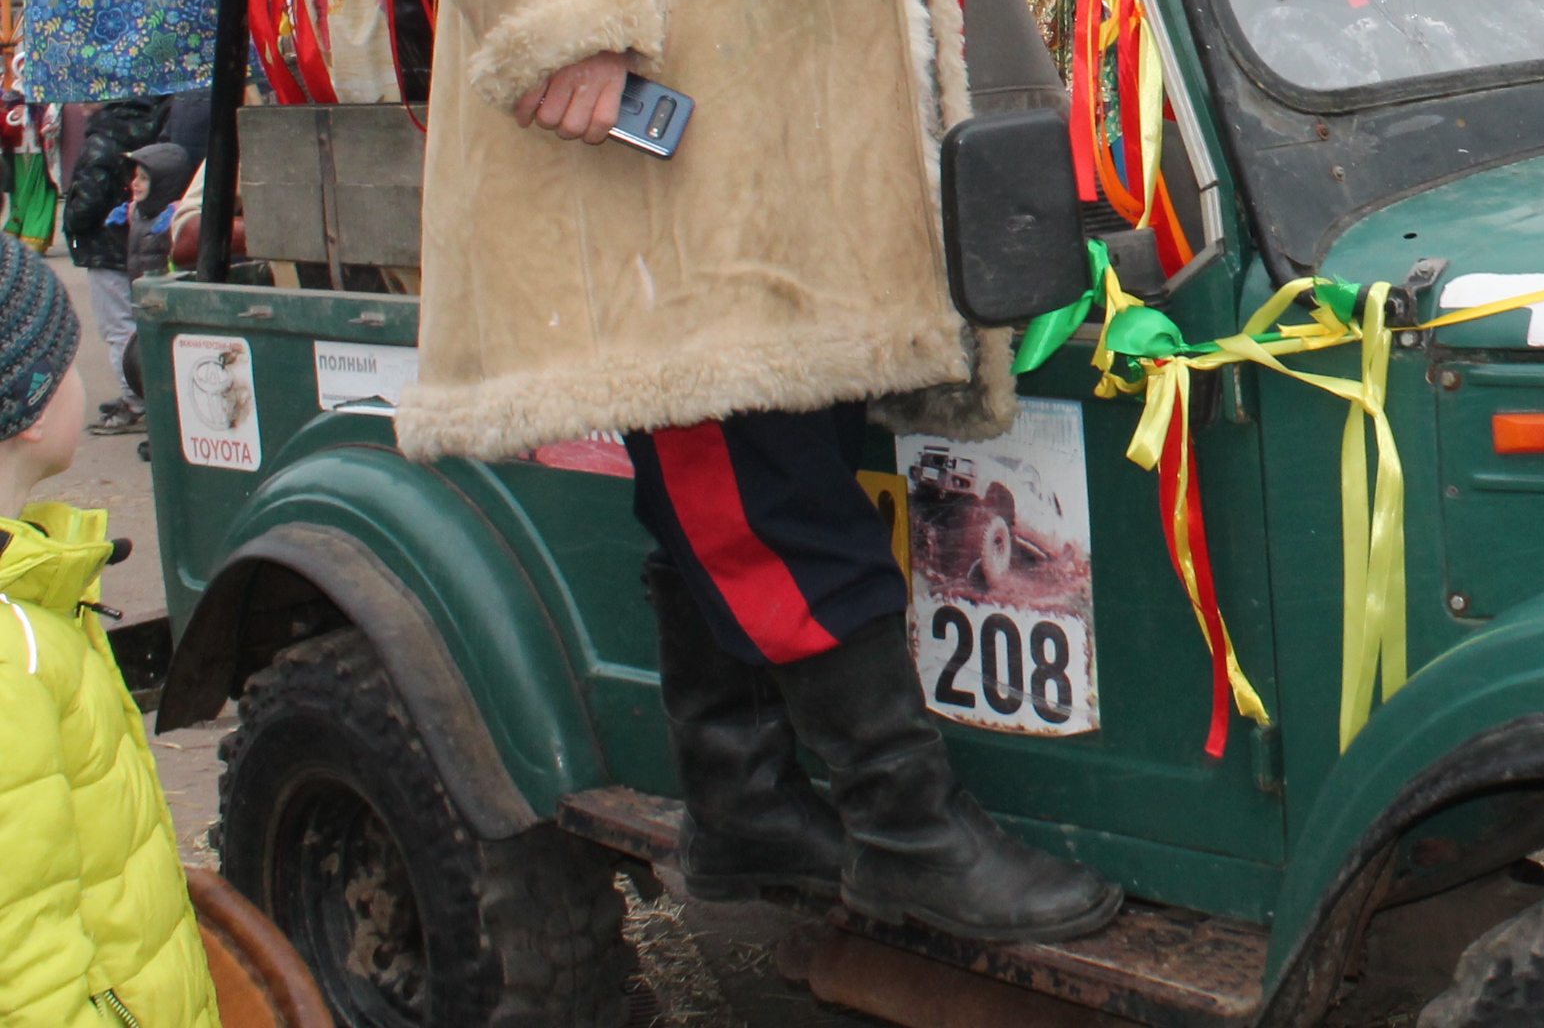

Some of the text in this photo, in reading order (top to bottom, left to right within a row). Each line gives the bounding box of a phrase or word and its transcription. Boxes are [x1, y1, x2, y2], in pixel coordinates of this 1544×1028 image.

[319, 353, 377, 374] ПОЛНЫЙ
[190, 437, 252, 464] TOYOTA
[932, 605, 1073, 724] 208
